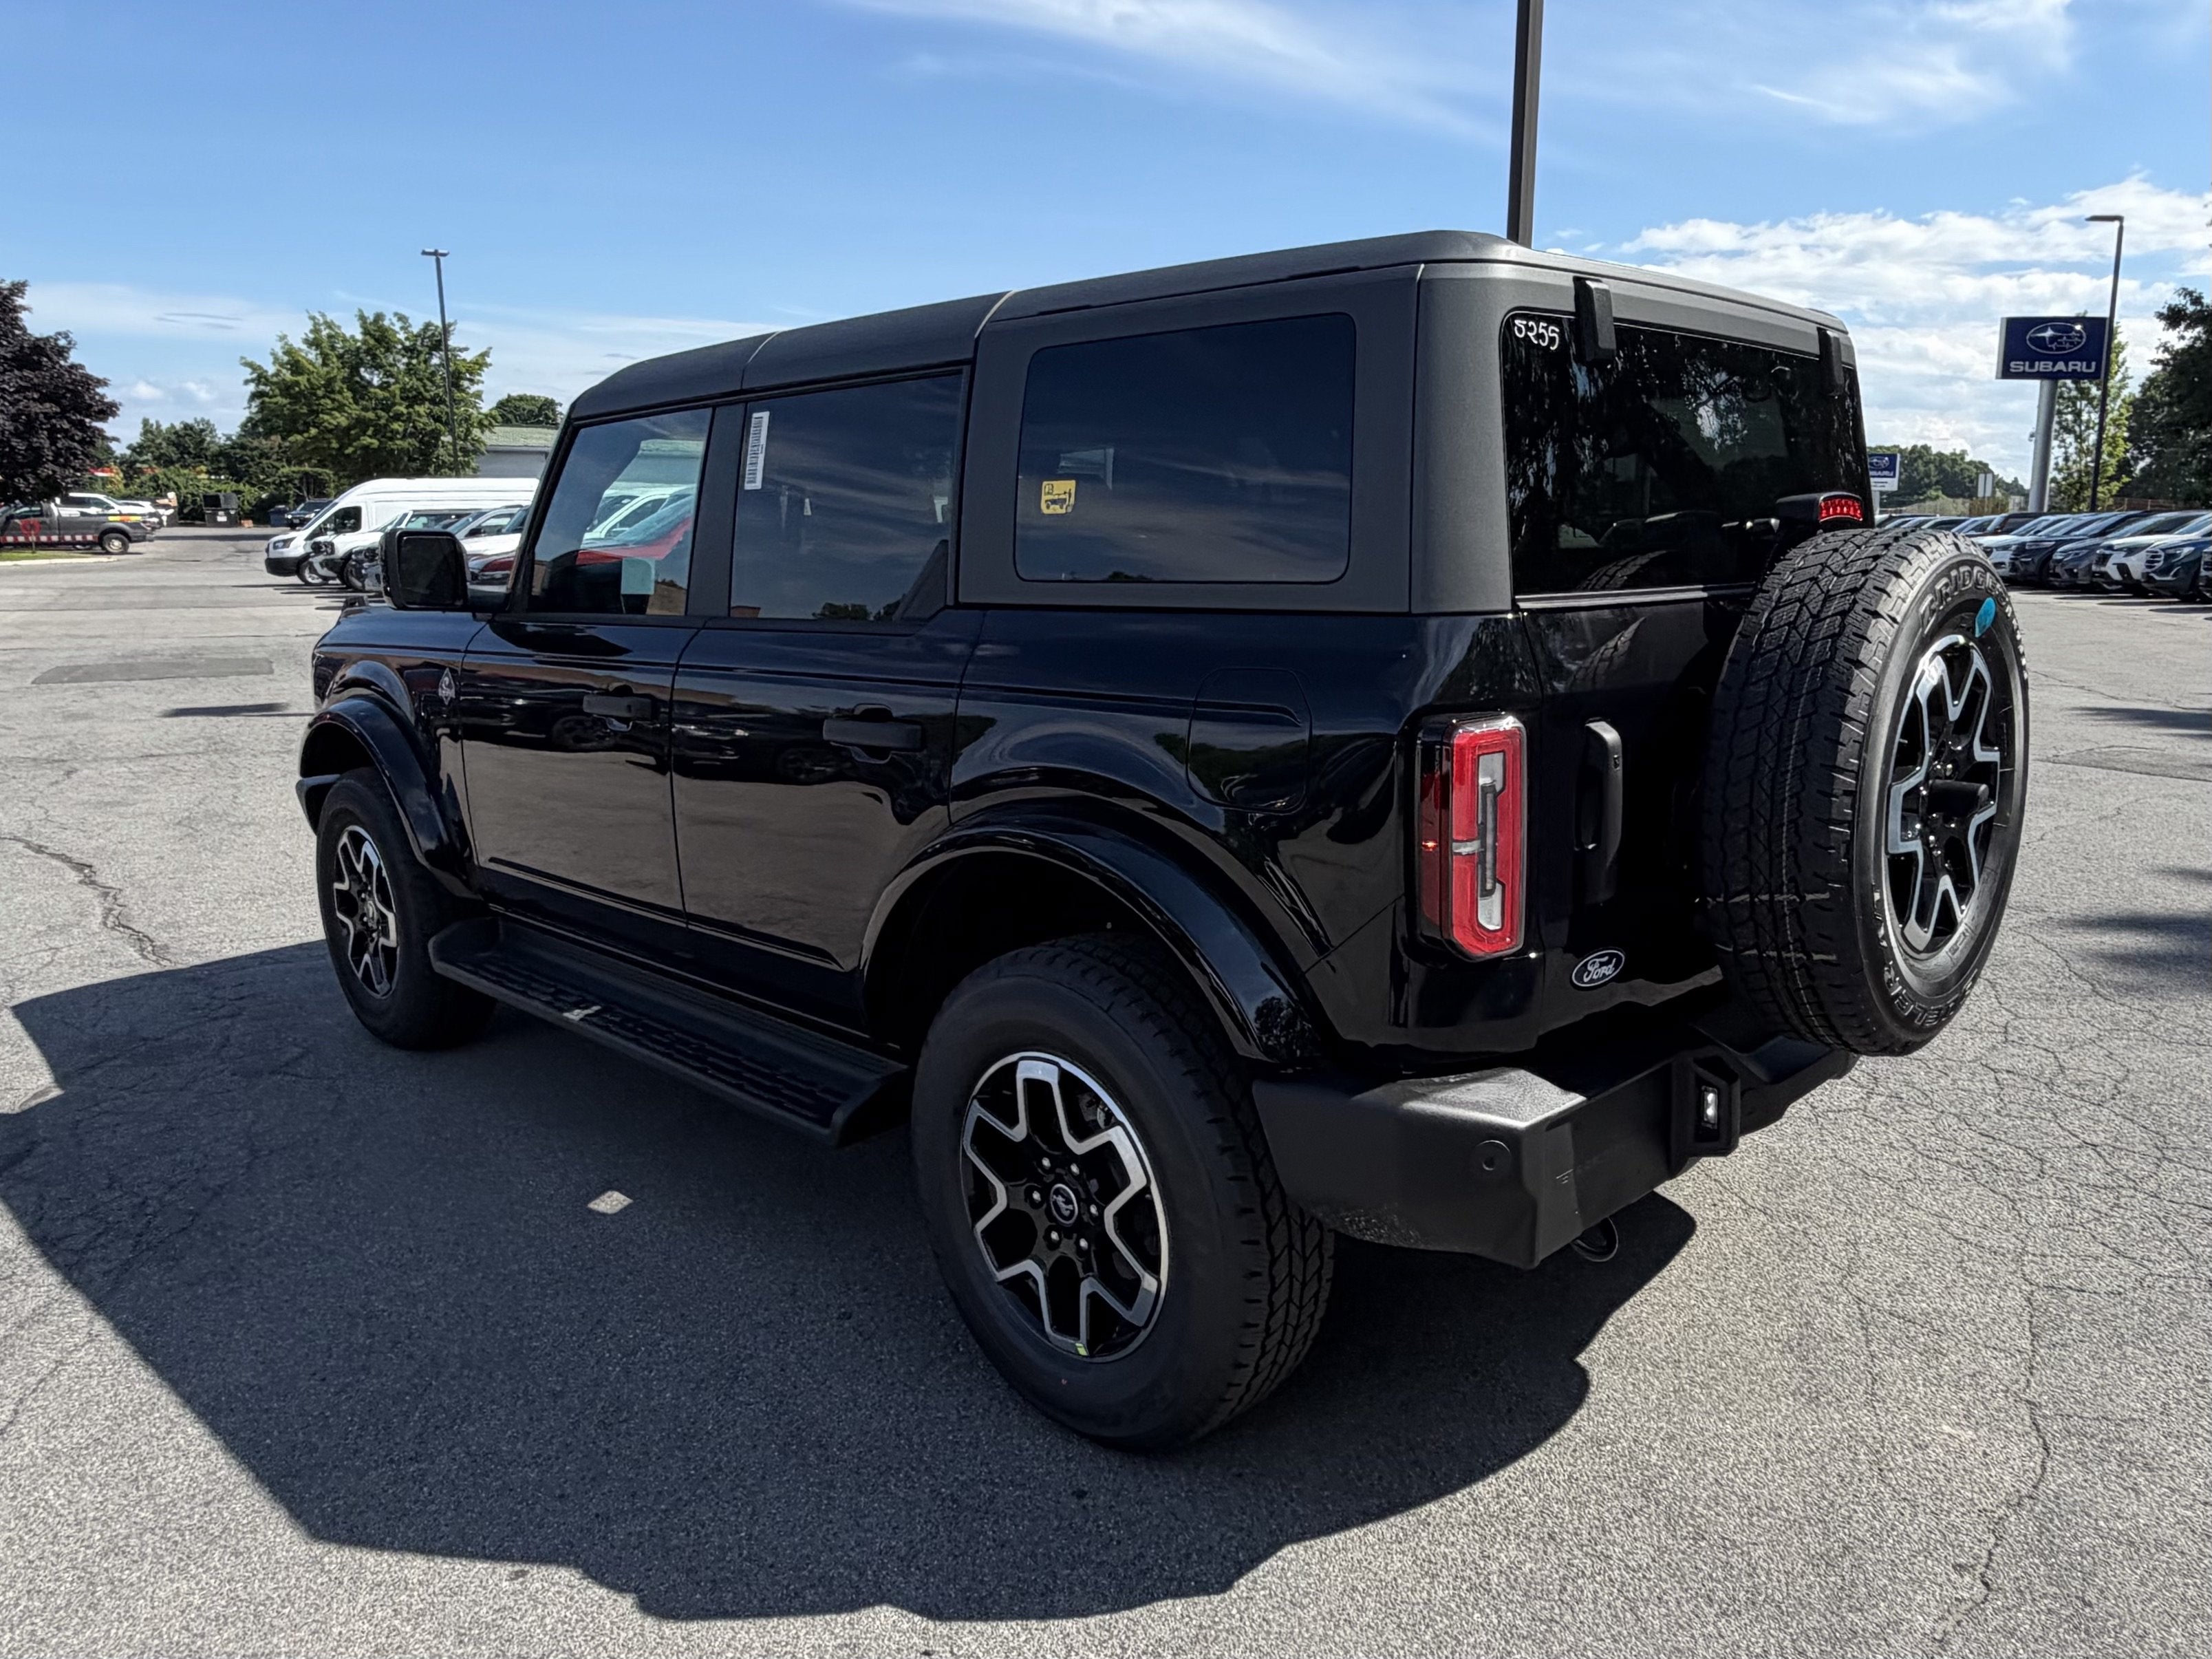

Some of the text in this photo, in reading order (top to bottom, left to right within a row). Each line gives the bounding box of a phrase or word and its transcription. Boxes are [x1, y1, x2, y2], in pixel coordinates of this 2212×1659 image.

[1514, 319, 1560, 351] 5255
[2009, 361, 2096, 373] SUBARU
[1583, 956, 1617, 983] Ford
